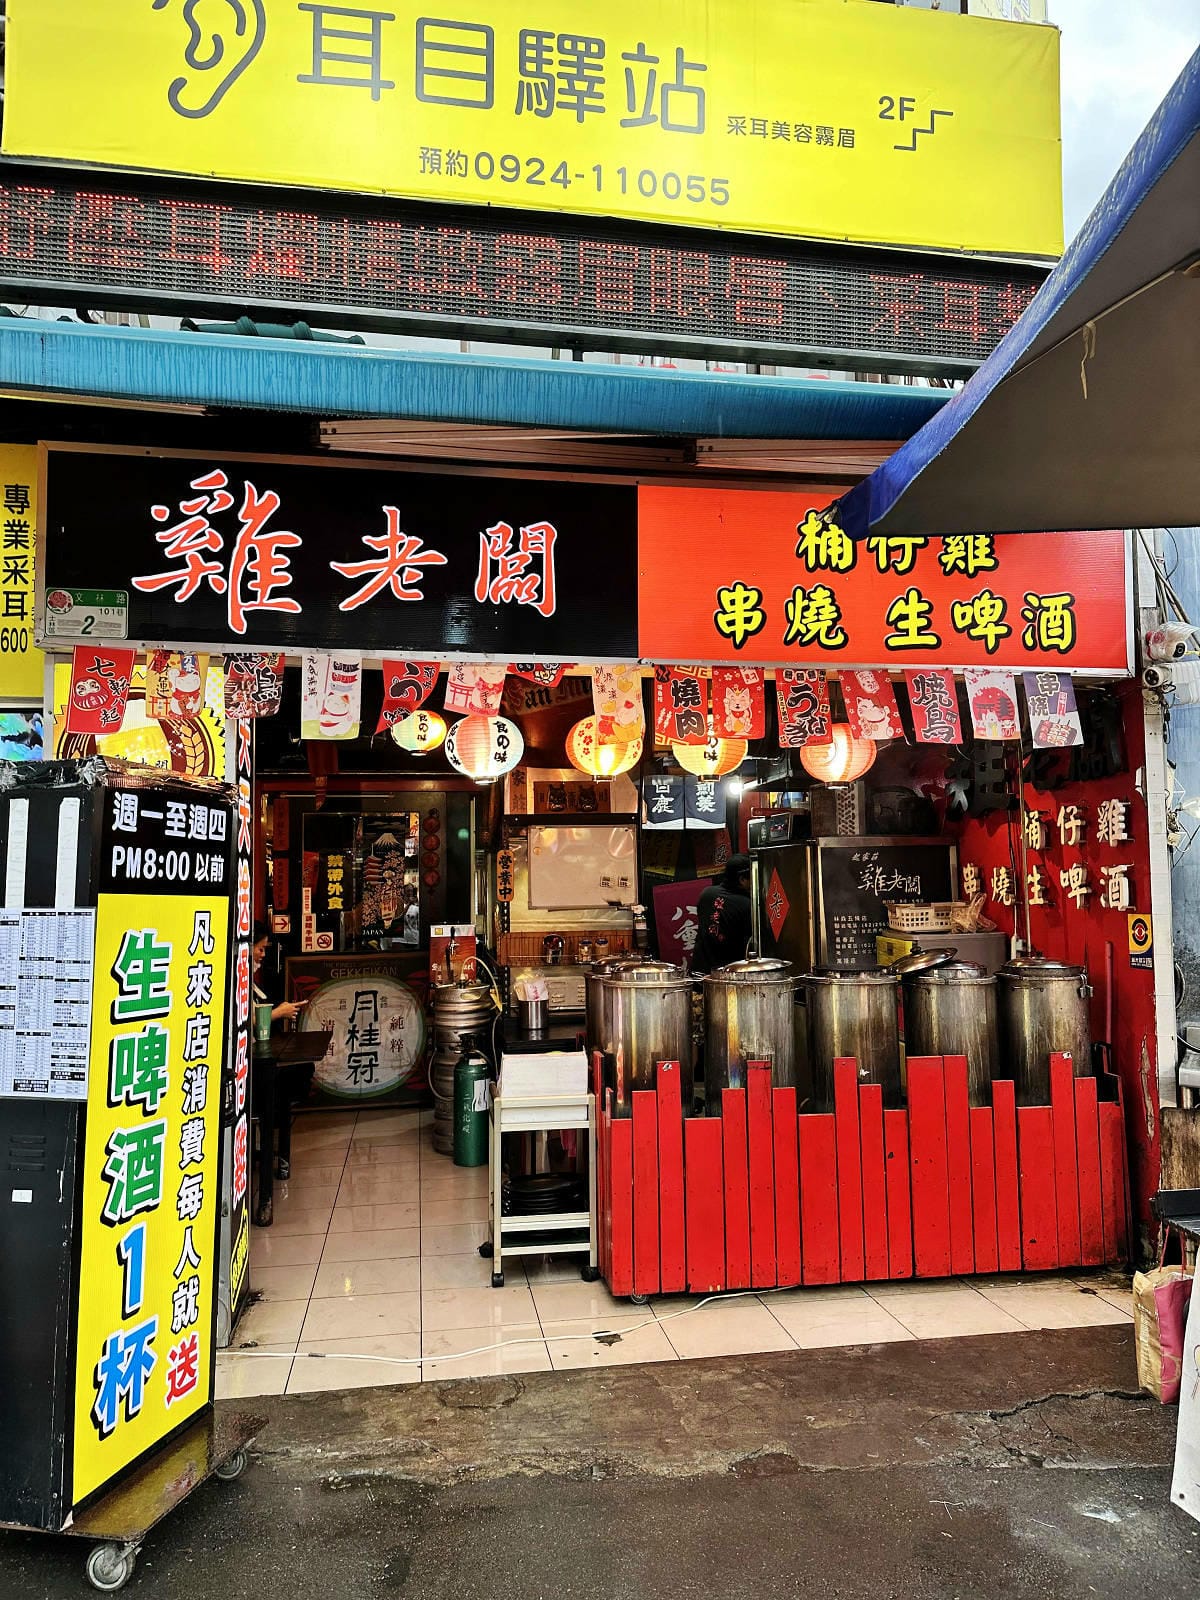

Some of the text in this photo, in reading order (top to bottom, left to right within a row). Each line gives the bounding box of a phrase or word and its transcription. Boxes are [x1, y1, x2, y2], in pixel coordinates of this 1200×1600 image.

[297, 3, 707, 135] 耳目驛站
[727, 115, 855, 150] 采耳美容霧眉
[878, 96, 915, 121] 2F
[2, 483, 30, 621] 專業采耳
[132, 468, 558, 634] 雞老闆
[797, 508, 998, 577] 桶仔雞
[0, 627, 29, 653] 600
[81, 615, 96, 635] 2
[714, 582, 1076, 653] 串燒 生啤酒
[111, 791, 227, 842] 週一至週四
[111, 845, 225, 883] PM8:00 以前
[327, 855, 344, 909] 禁帶外食
[498, 854, 512, 899] 營業中
[345, 990, 381, 1084] 月桂冠
[91, 928, 173, 1440] 生啤酒1杯
[166, 911, 215, 1409] 凡來店消費每人就送
